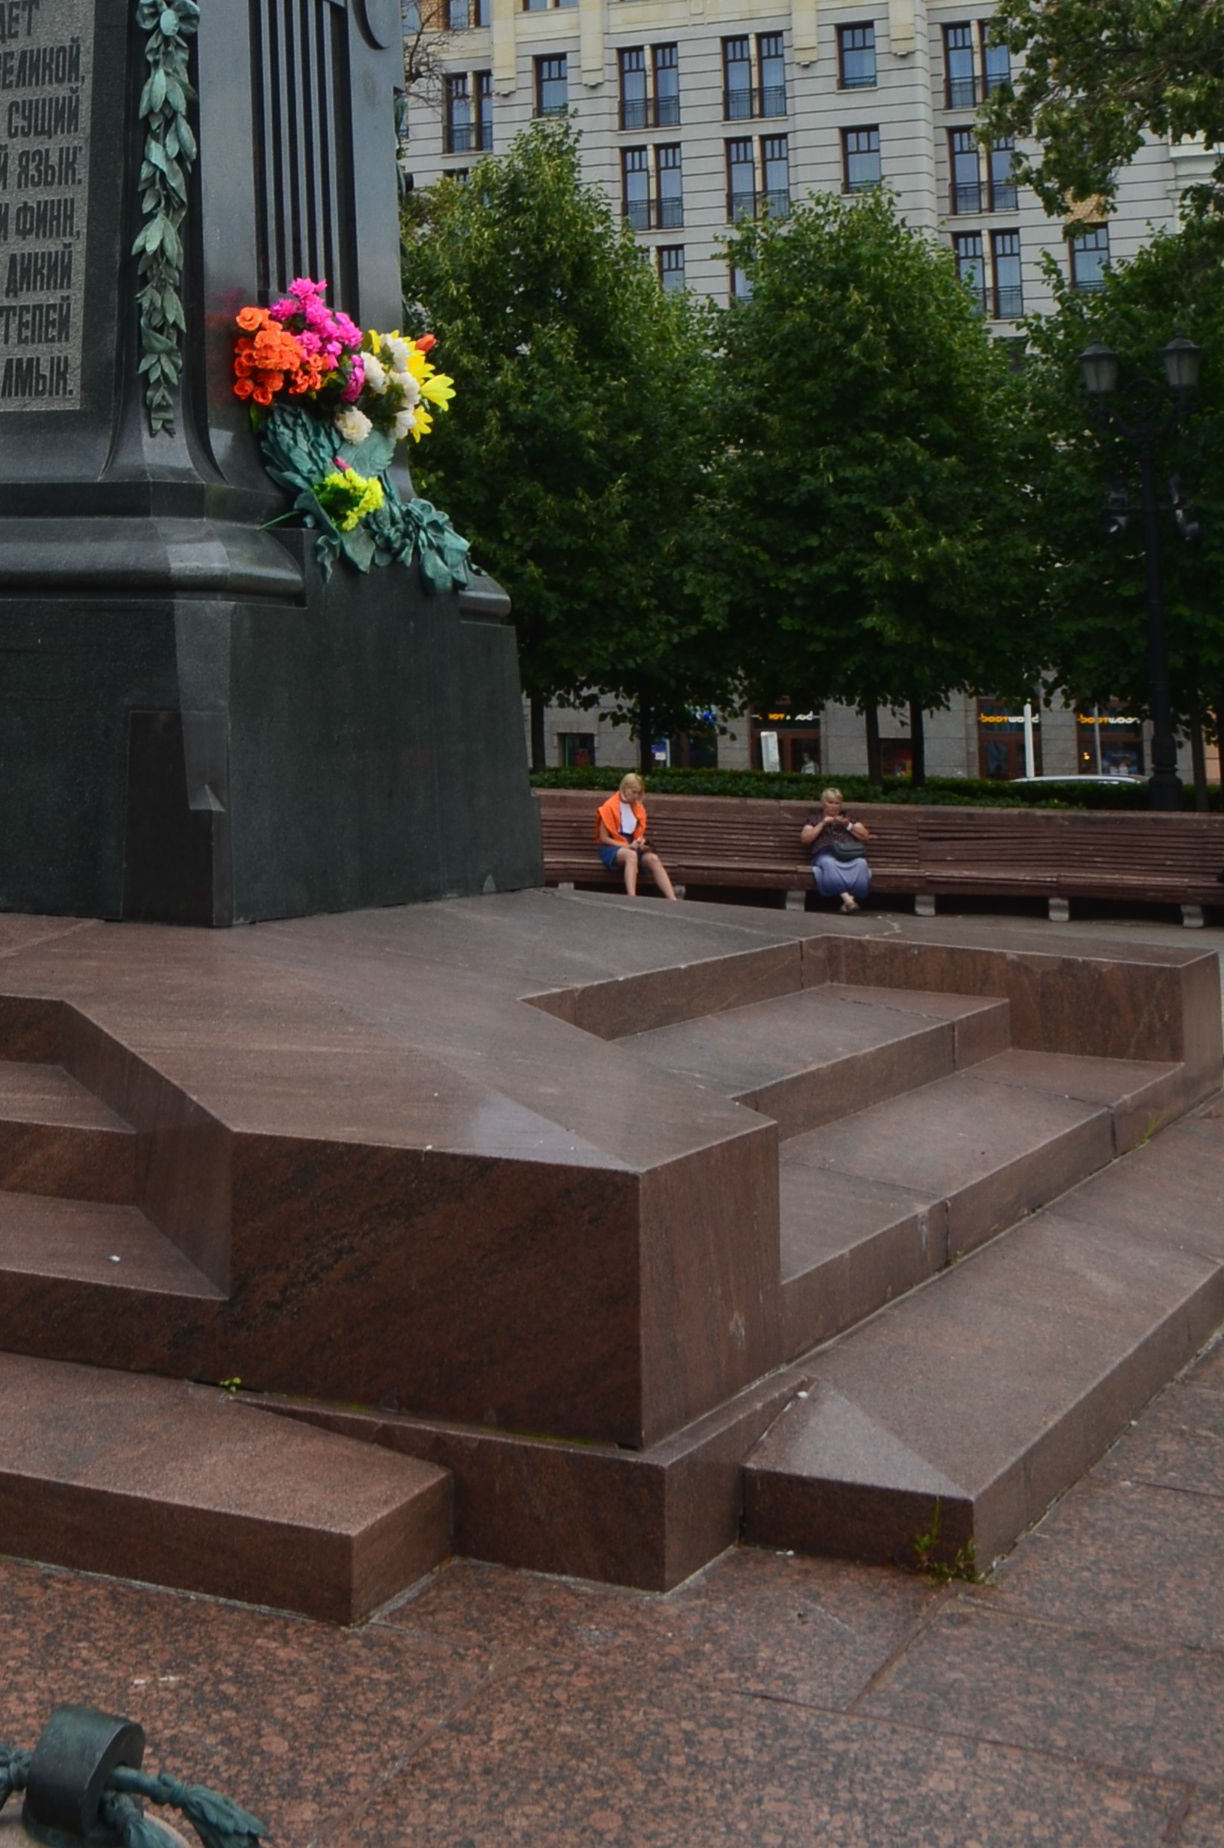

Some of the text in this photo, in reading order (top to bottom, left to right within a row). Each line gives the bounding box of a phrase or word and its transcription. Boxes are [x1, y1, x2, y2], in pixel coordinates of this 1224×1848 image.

[7, 86, 80, 140] СУЩИЙ
[15, 197, 80, 241] ФИНН,
[5, 242, 73, 298] ДИКИЙ
[980, 712, 1040, 724] bootwod
